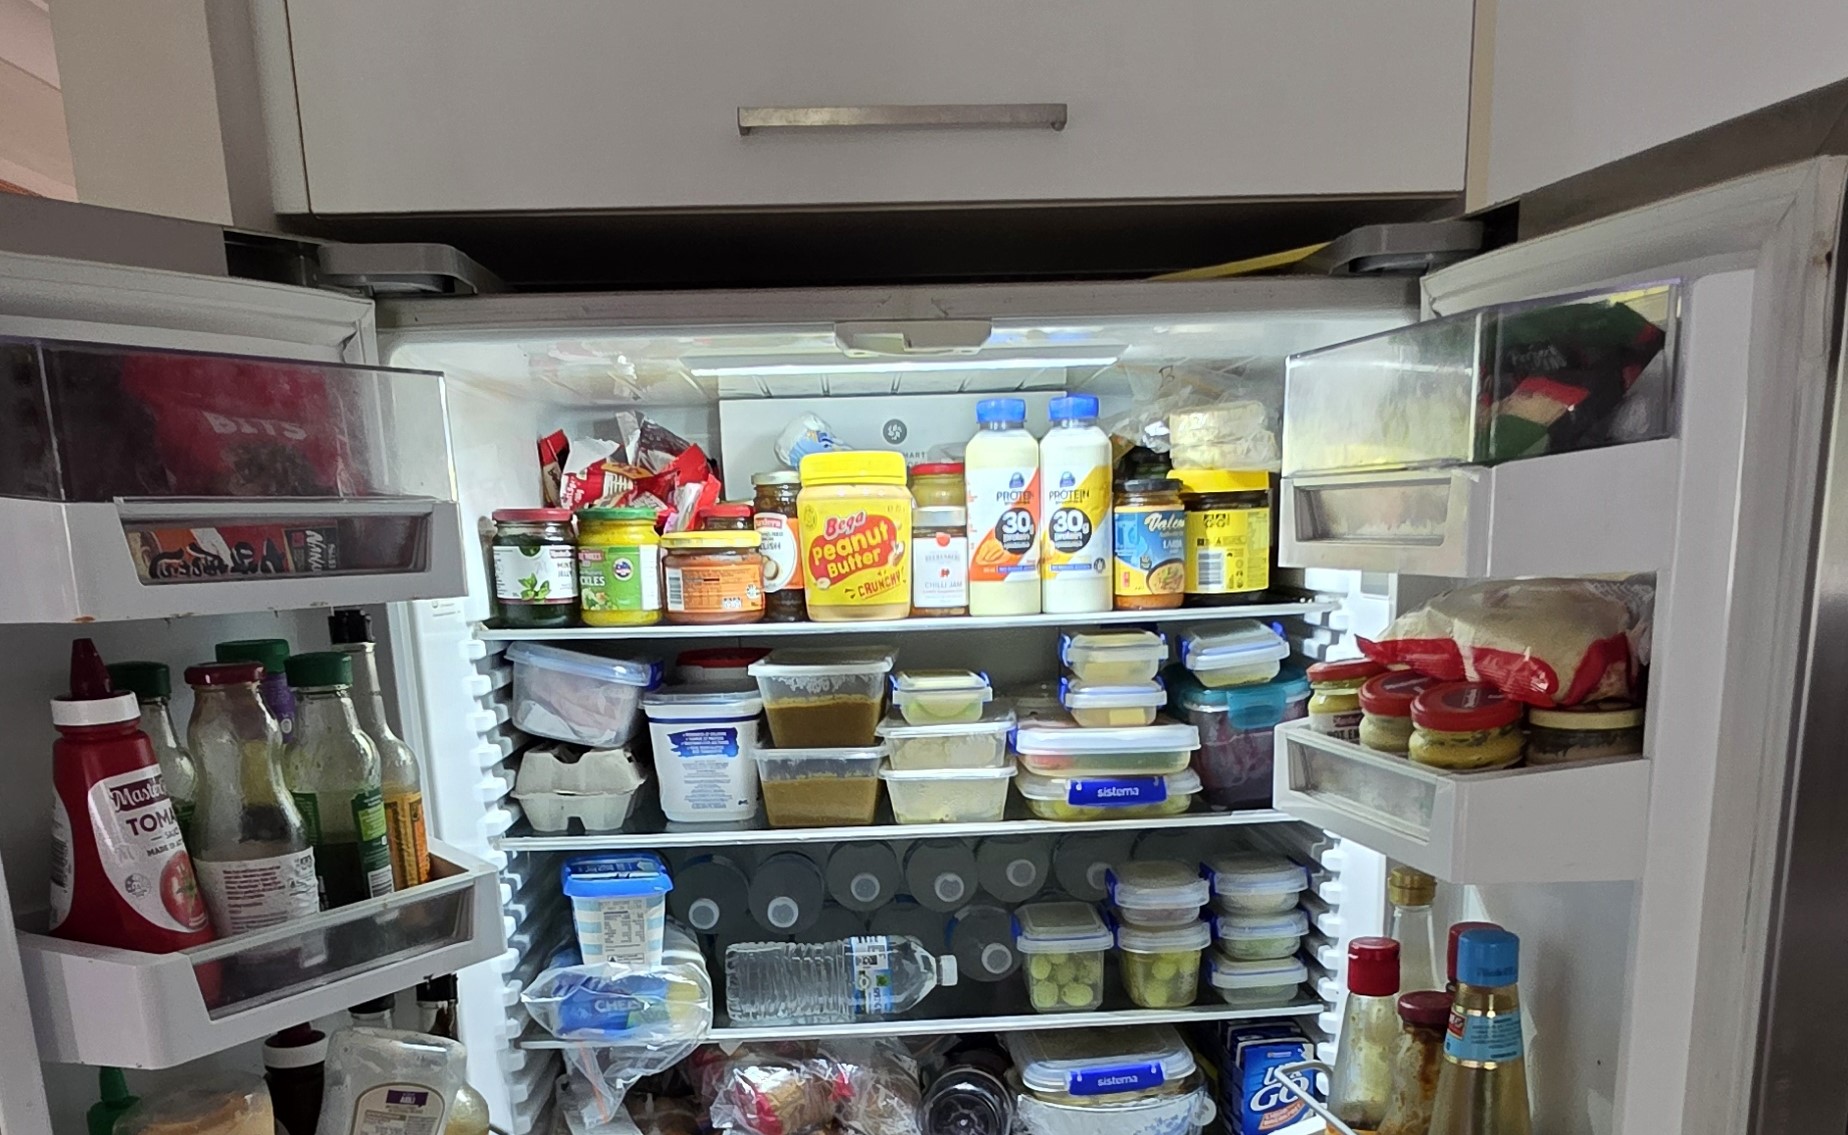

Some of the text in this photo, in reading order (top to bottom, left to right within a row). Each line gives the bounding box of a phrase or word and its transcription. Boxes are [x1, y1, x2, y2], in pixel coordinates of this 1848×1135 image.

[824, 511, 867, 540] Bega
[1053, 509, 1090, 535] 30g
[812, 520, 889, 566] Peanut
[826, 547, 881, 578] Butter
[857, 571, 901, 597] CRUNCHY
[1097, 786, 1139, 798] sistema
[1097, 1075, 1138, 1087] sistema
